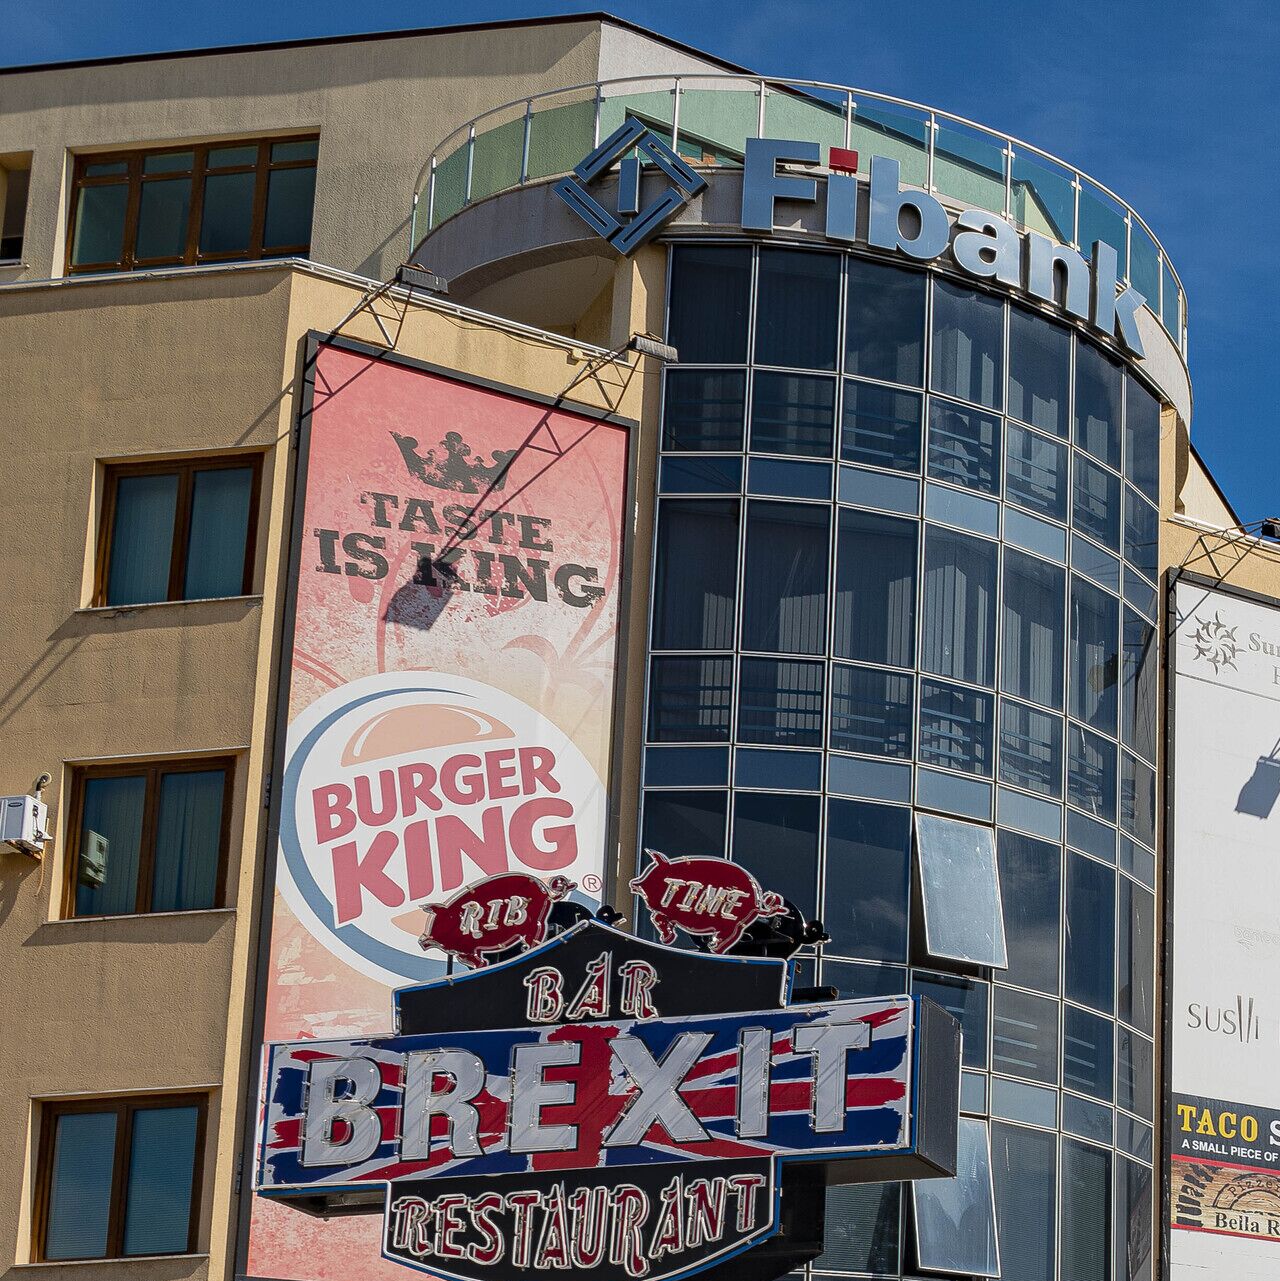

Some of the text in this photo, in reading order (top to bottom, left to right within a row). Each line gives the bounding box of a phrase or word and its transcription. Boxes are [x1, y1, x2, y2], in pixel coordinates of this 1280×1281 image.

[742, 138, 1148, 360] Fibank
[361, 490, 554, 552] TASTE
[313, 527, 606, 609] IS KING
[311, 746, 562, 846] BURGER
[330, 799, 578, 926] KING
[660, 877, 749, 919] TIME
[459, 893, 528, 936] RIB
[523, 950, 660, 1023] BAR
[299, 1021, 873, 1169] BREXIT
[1176, 1103, 1259, 1143] TACO
[1181, 1138, 1191, 1149] A
[1192, 1139, 1230, 1156] SMALL
[1230, 1145, 1262, 1161] PIECE
[1263, 1150, 1279, 1163] OF
[390, 1171, 767, 1278] RESTAURANT
[1214, 1211, 1261, 1235] Bella
